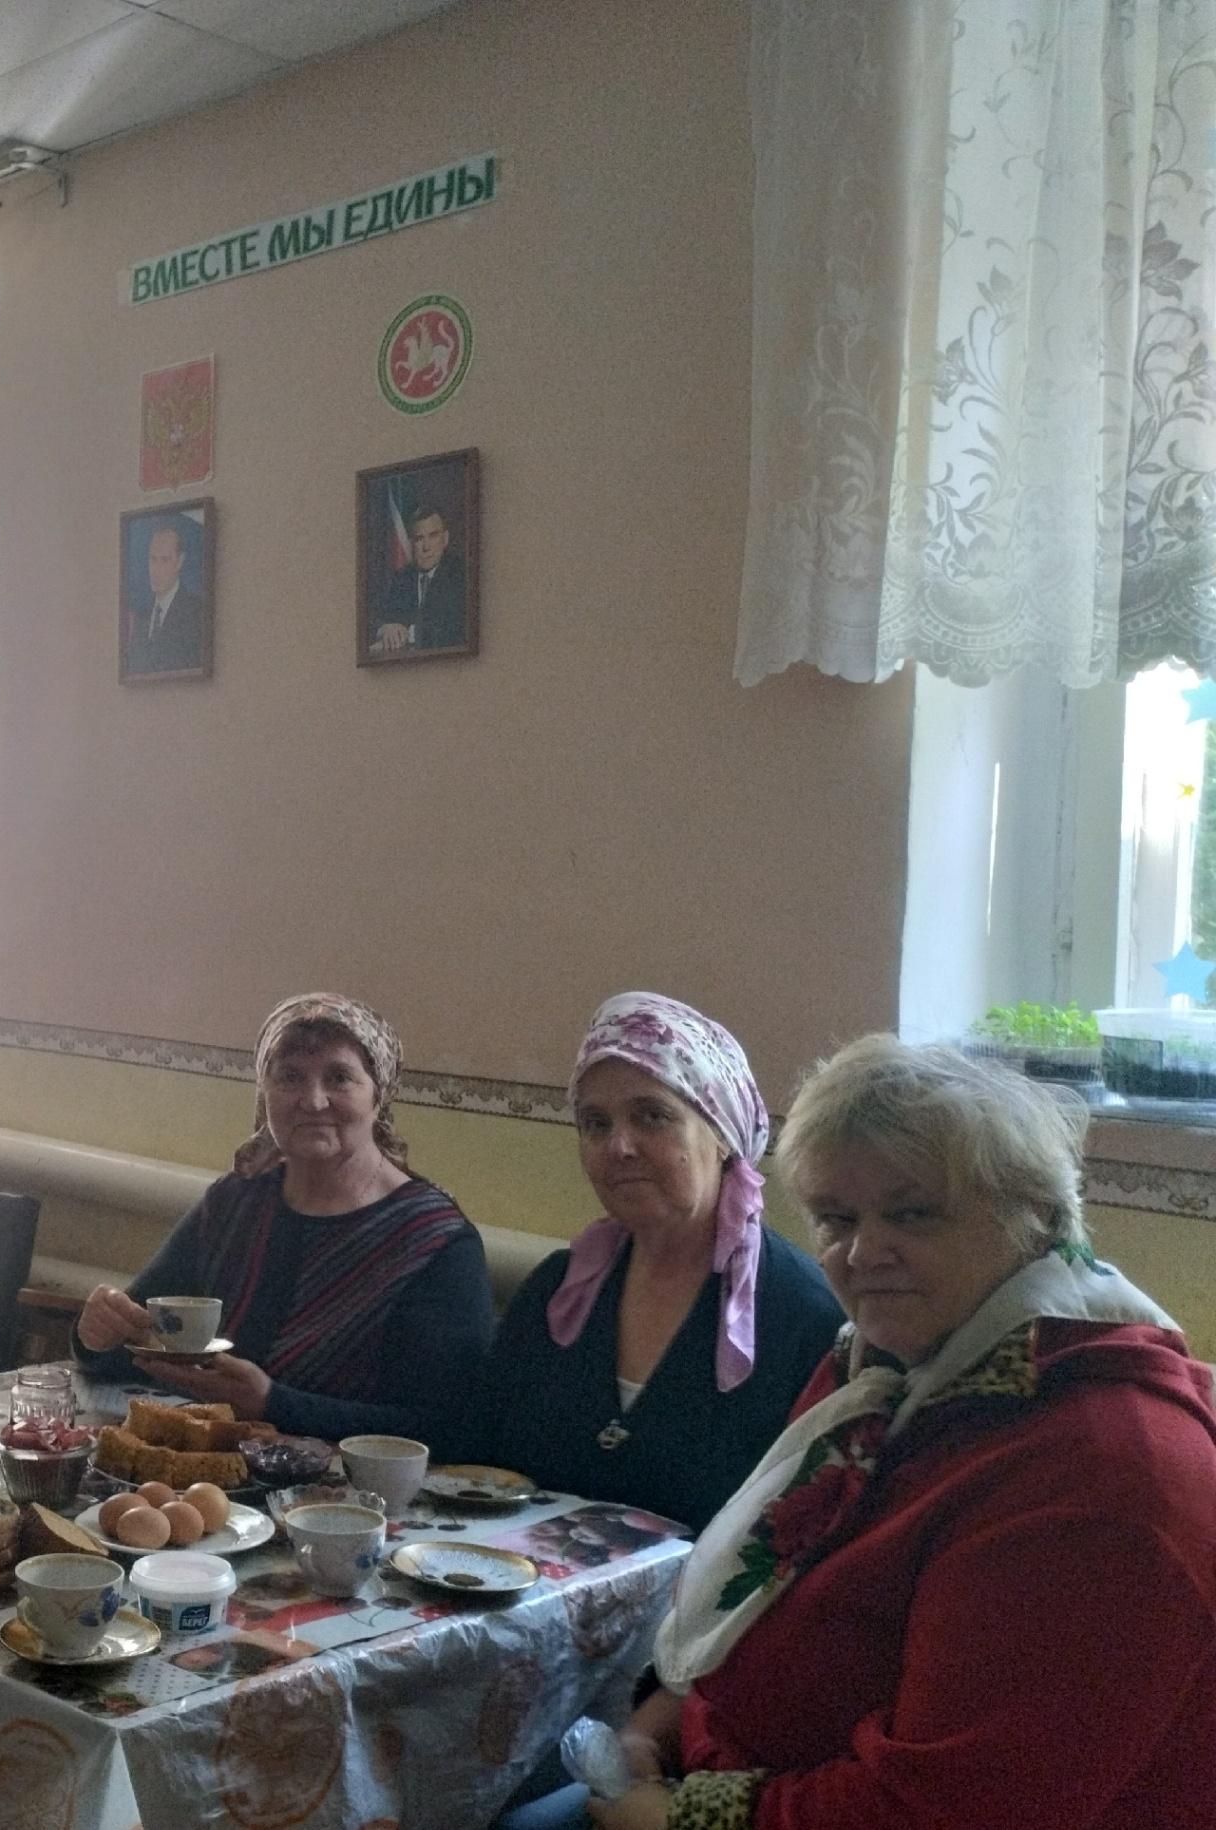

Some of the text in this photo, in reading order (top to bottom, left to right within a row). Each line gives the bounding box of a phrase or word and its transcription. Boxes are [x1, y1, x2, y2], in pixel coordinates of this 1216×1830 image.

[132, 157, 495, 302] ВМЕСТЕ МЫ ЕДИНЫ
